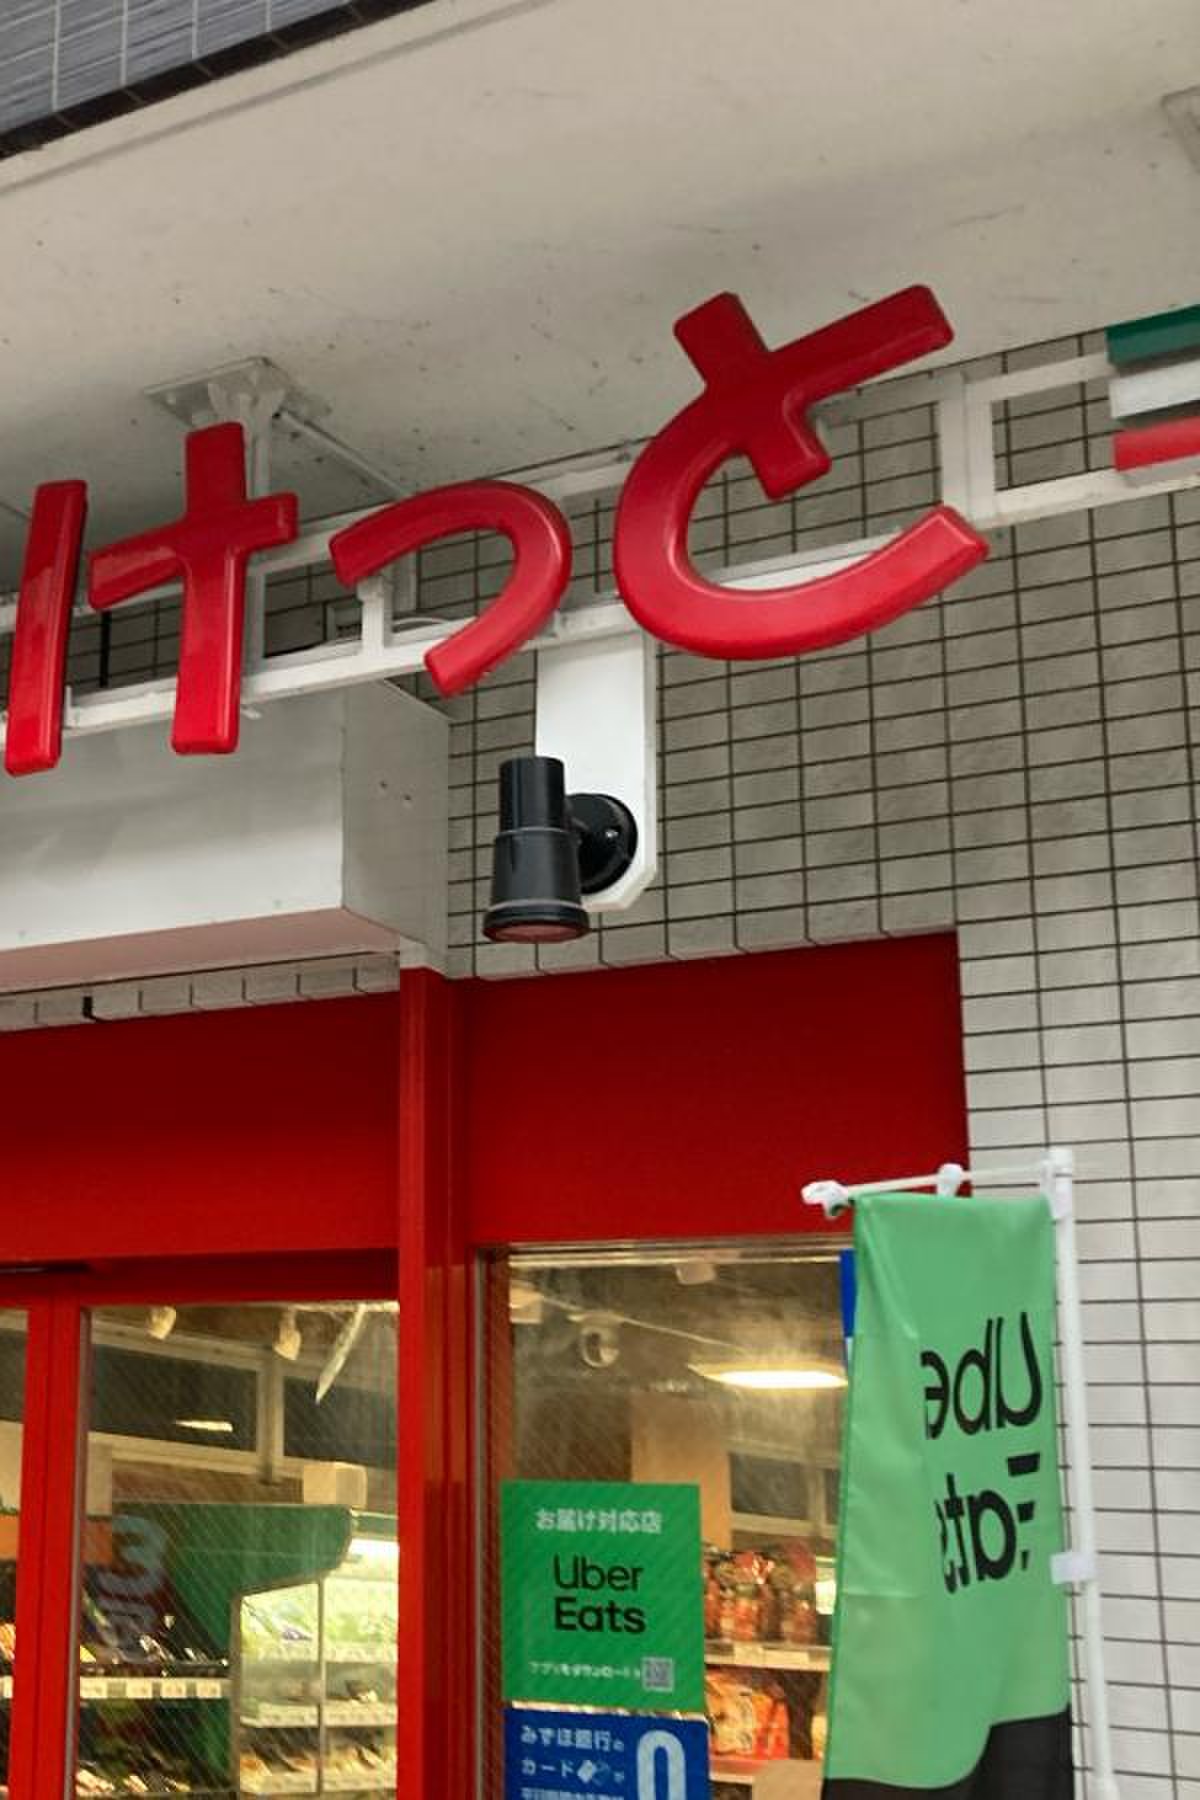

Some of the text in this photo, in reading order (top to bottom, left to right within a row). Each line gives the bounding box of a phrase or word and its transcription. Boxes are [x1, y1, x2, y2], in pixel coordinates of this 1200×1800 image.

[535, 1508, 662, 1534] お届け対応店
[553, 1554, 643, 1592] Uber
[554, 1597, 646, 1634] Eats
